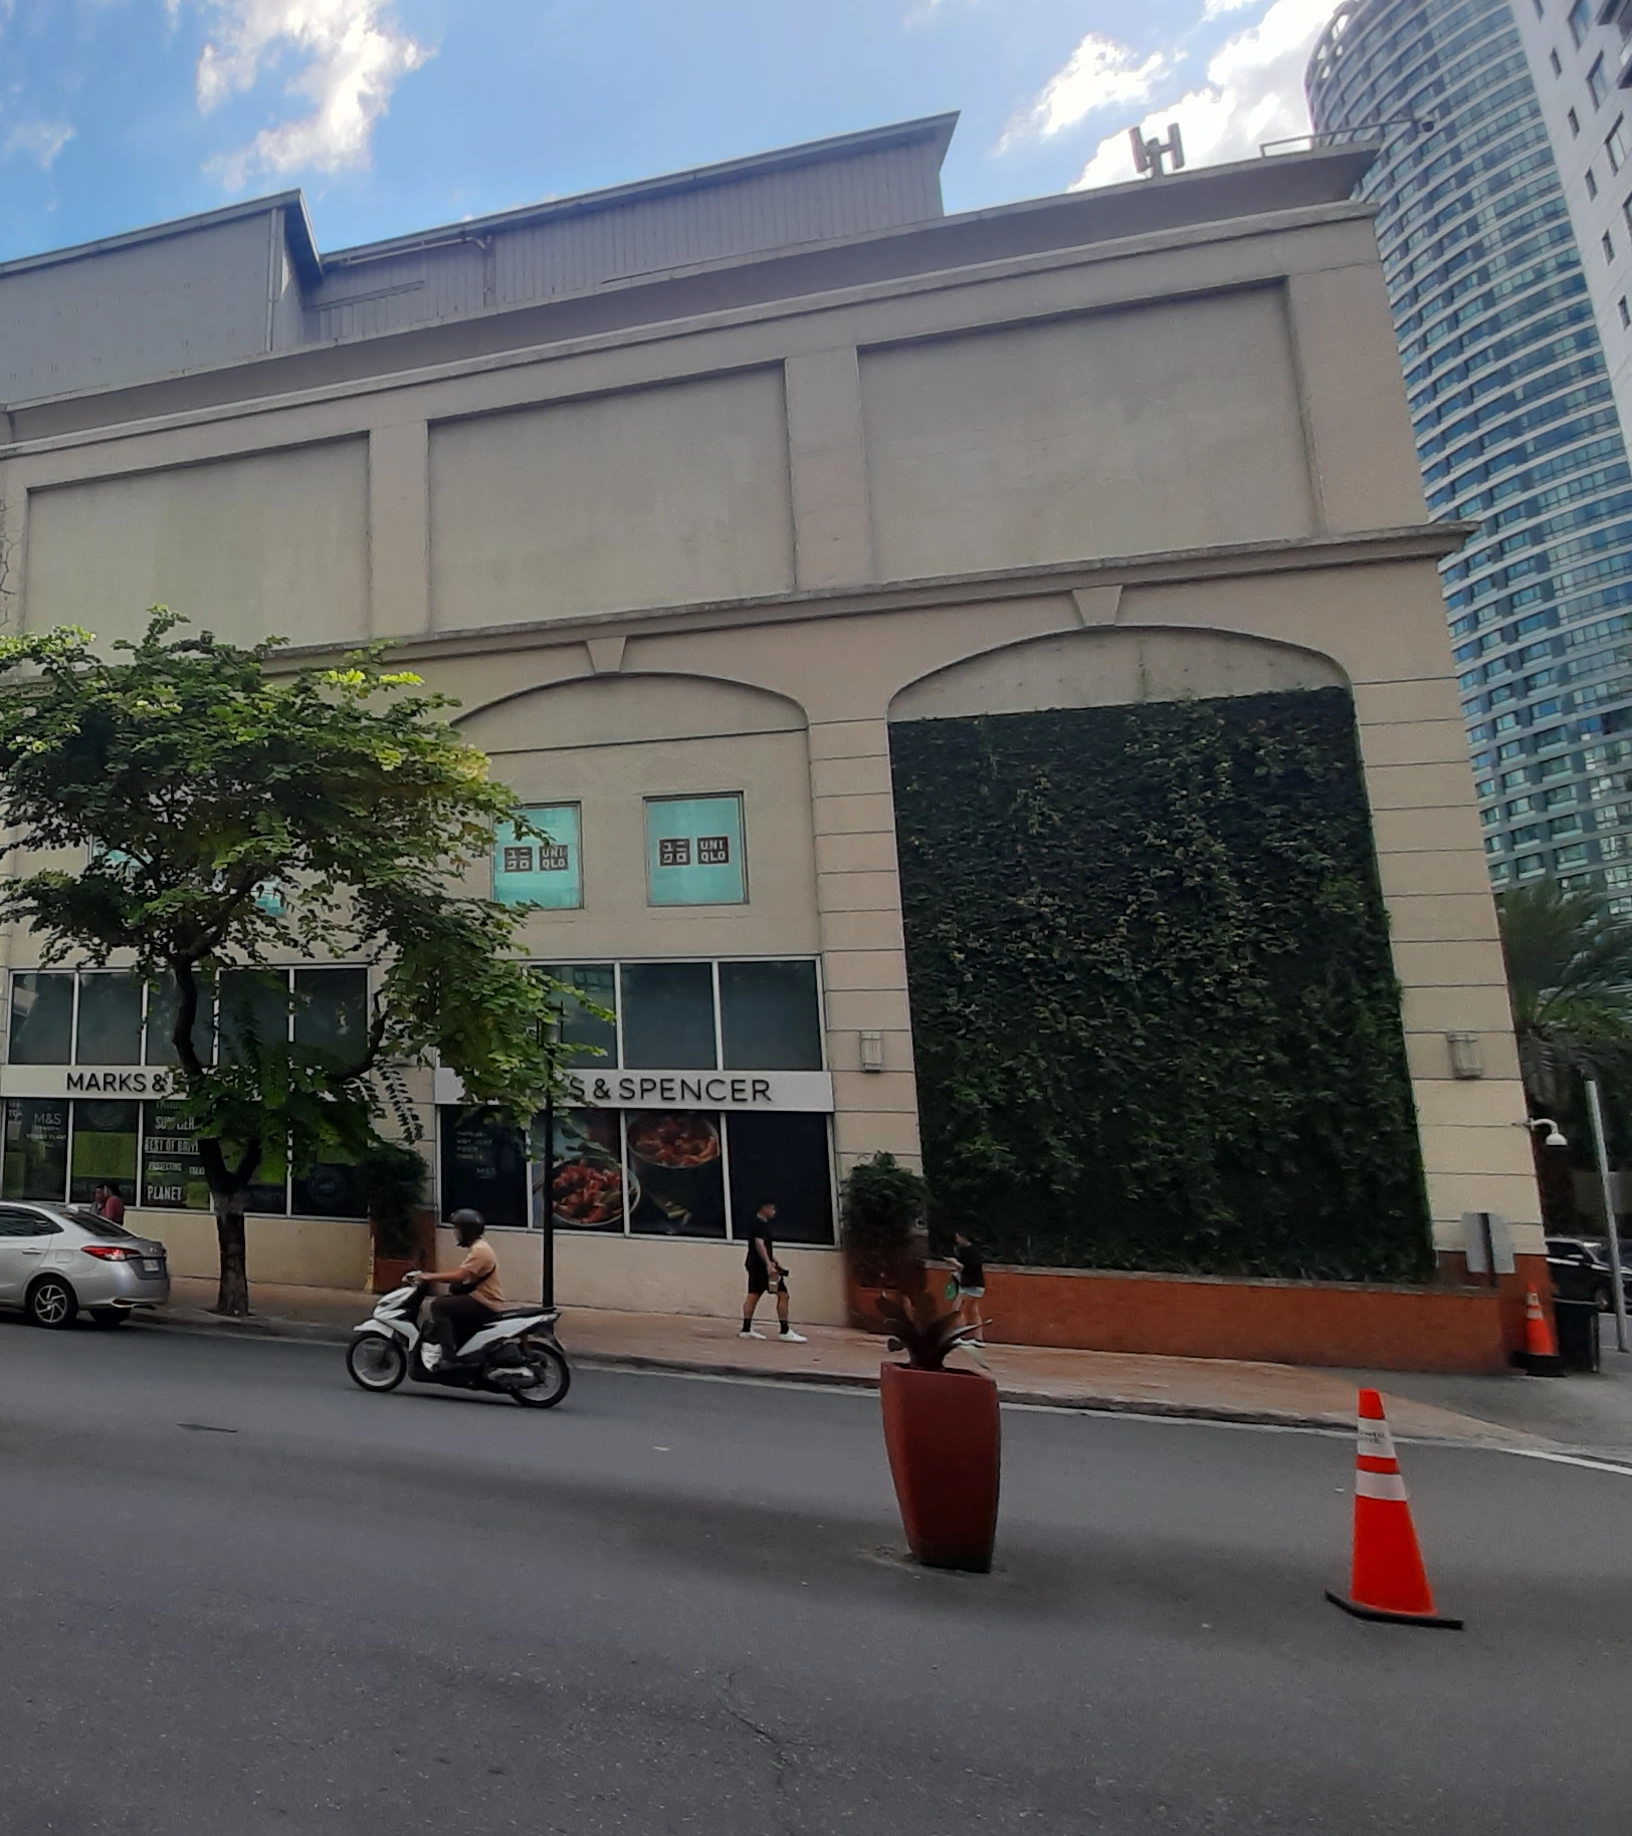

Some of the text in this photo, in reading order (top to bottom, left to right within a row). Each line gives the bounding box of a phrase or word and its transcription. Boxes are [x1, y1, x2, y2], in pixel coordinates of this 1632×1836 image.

[700, 839, 725, 851] UNI
[701, 850, 727, 863] QLO
[65, 1072, 169, 1093] MARKS &
[593, 1078, 612, 1100] &
[618, 1078, 772, 1103] SPENCER
[34, 1112, 62, 1125] M&S
[147, 1185, 183, 1201] PLANET
